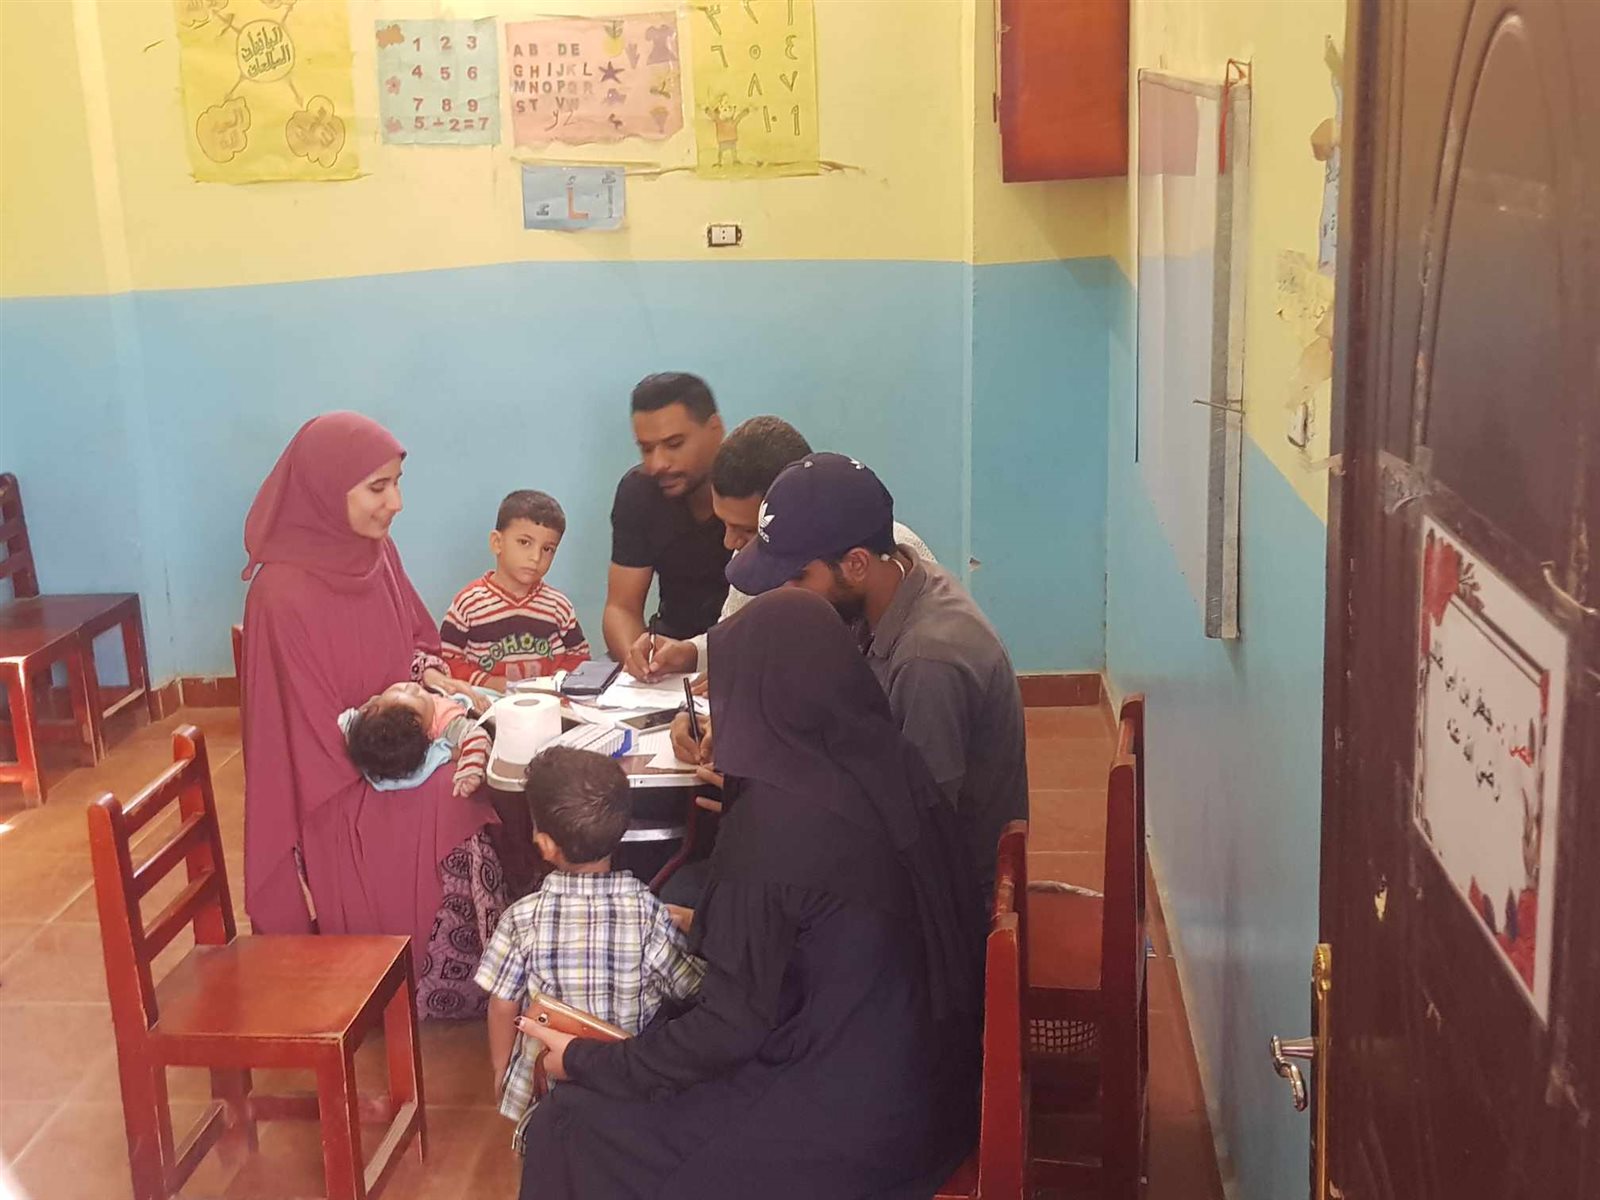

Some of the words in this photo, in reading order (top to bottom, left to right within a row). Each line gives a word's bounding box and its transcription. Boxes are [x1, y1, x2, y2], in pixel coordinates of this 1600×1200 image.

[413, 37, 421, 52] 1
[440, 36, 452, 50] 2
[466, 35, 477, 50] 3
[411, 64, 423, 79] 4
[440, 66, 451, 80] 5
[467, 66, 478, 80] 6
[413, 97, 424, 112] 7
[441, 98, 452, 112] 8
[467, 98, 478, 112] 9
